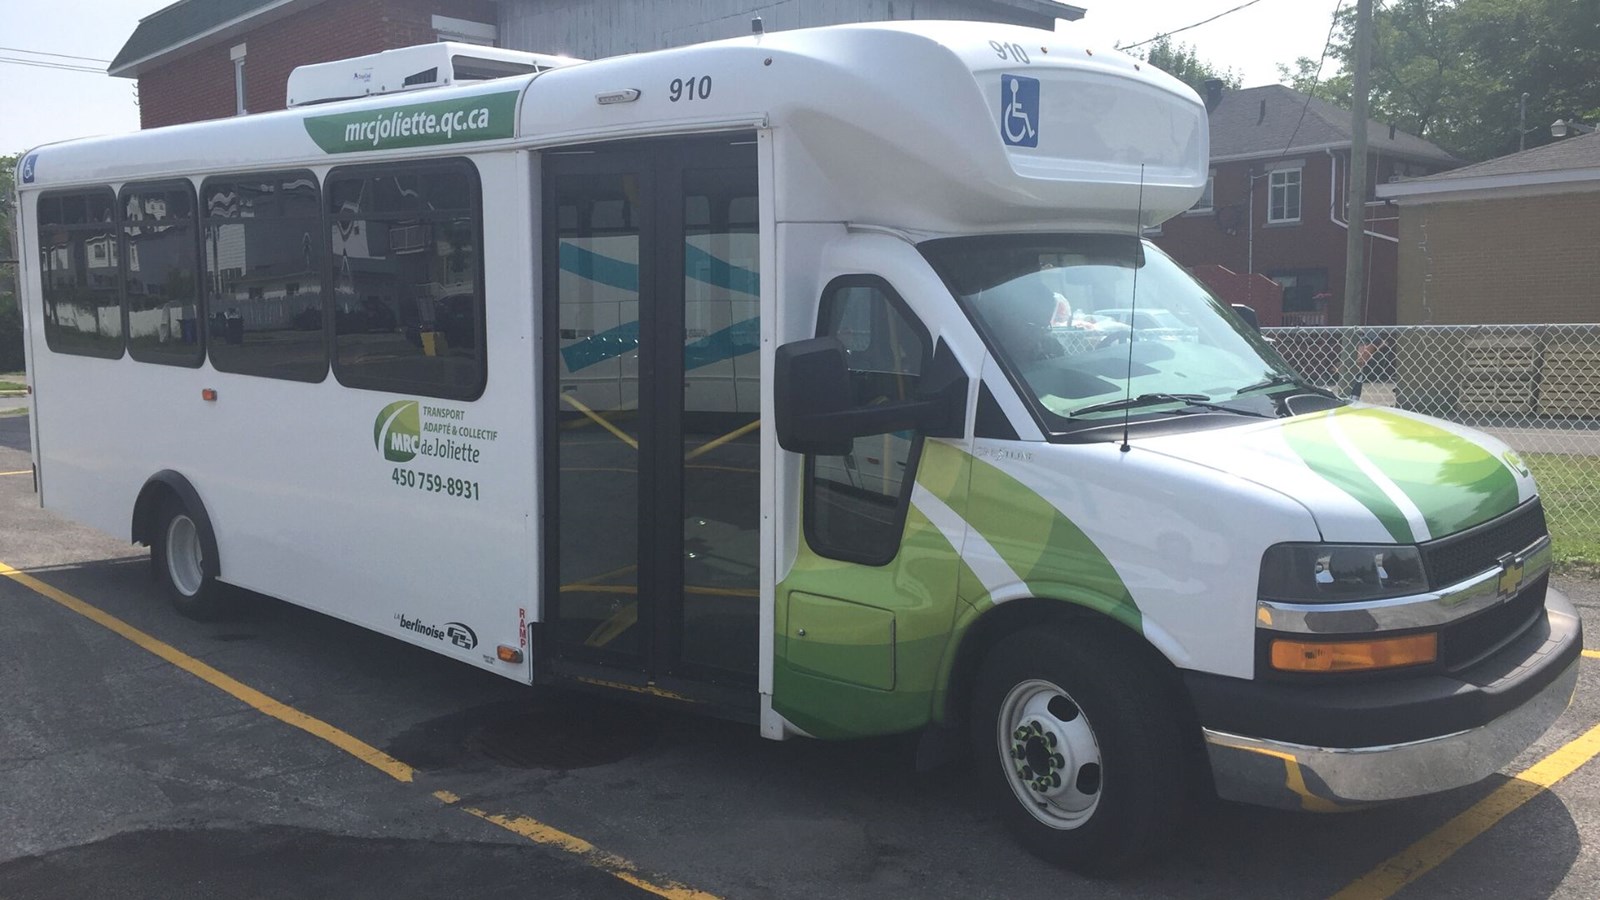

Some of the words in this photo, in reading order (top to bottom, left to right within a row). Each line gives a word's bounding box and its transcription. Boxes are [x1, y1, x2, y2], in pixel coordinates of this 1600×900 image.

[989, 40, 1030, 64] 910
[669, 75, 712, 102] 910
[344, 107, 489, 145] mrcjoliette.qc.ca
[423, 406, 465, 420] TRANSPORT
[391, 432, 419, 454] MRC
[423, 421, 451, 435] ADAPTÉ
[452, 427, 458, 435] &
[458, 426, 498, 440] COLLECTIF
[391, 467, 415, 487] 450
[418, 471, 480, 500] 759-8931
[400, 613, 445, 640] berlinoise
